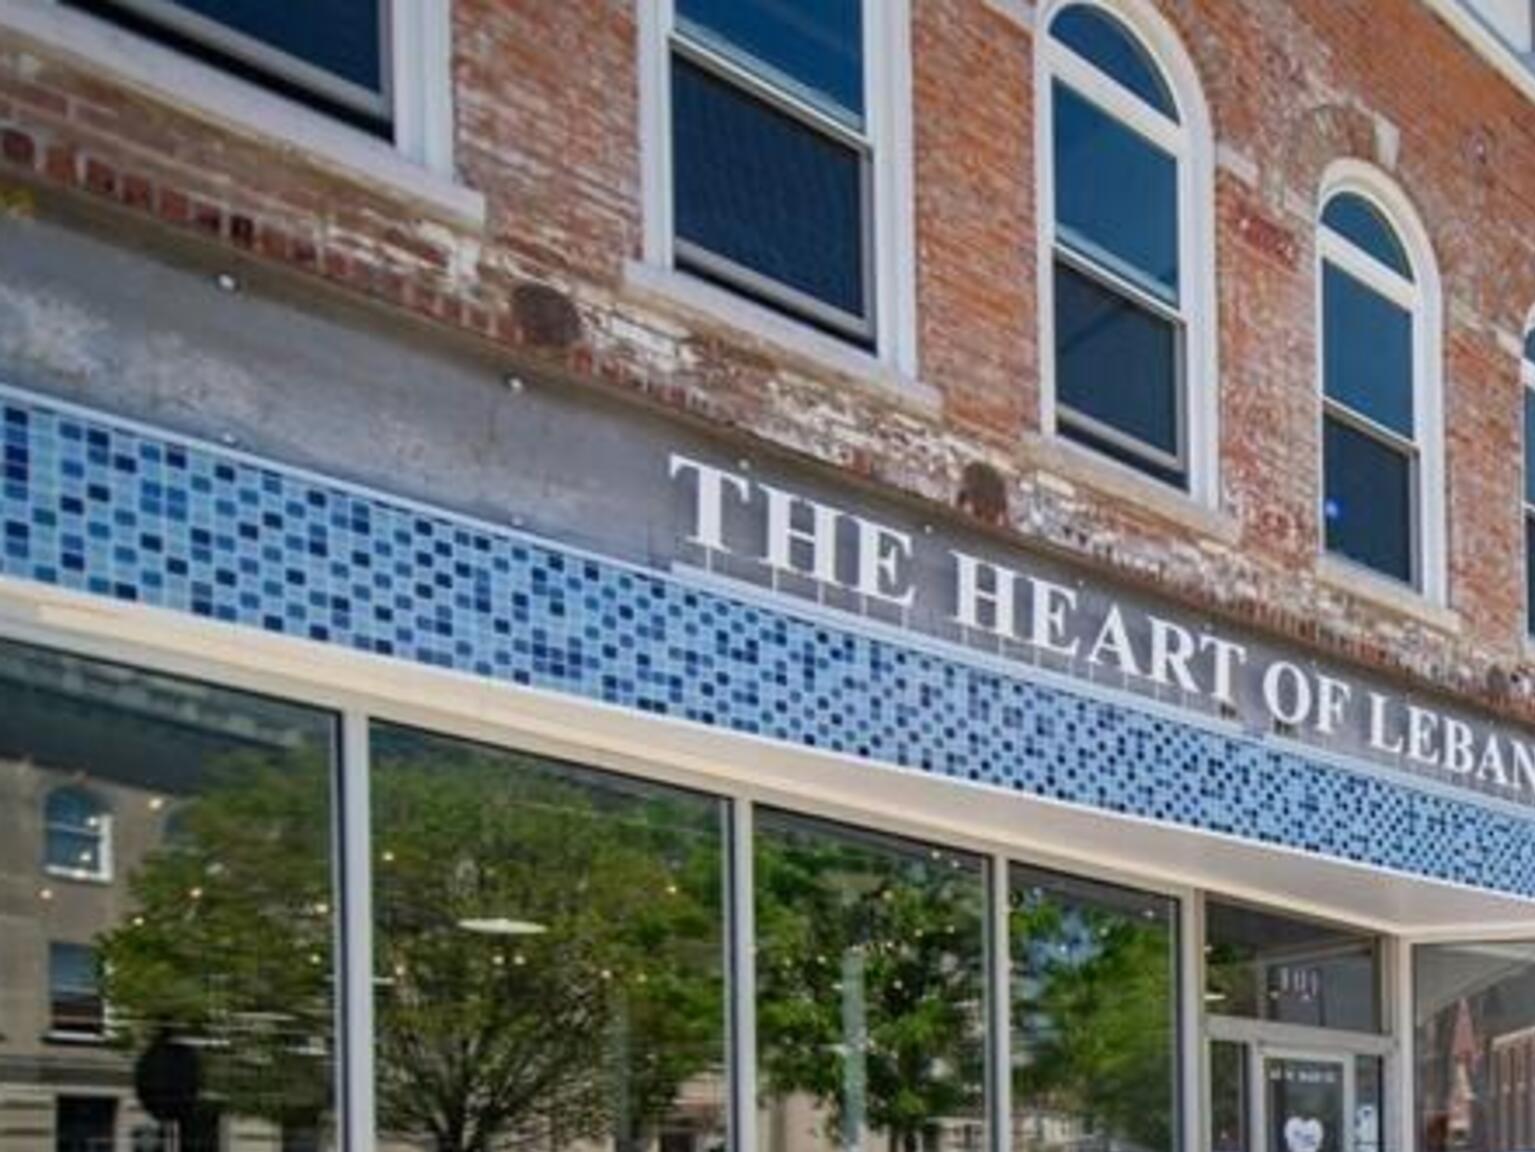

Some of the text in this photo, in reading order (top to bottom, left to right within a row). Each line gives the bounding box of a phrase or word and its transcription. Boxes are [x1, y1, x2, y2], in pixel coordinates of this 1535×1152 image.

[669, 452, 915, 607] THE
[949, 549, 1247, 704] HEART
[1263, 660, 1352, 735] OF
